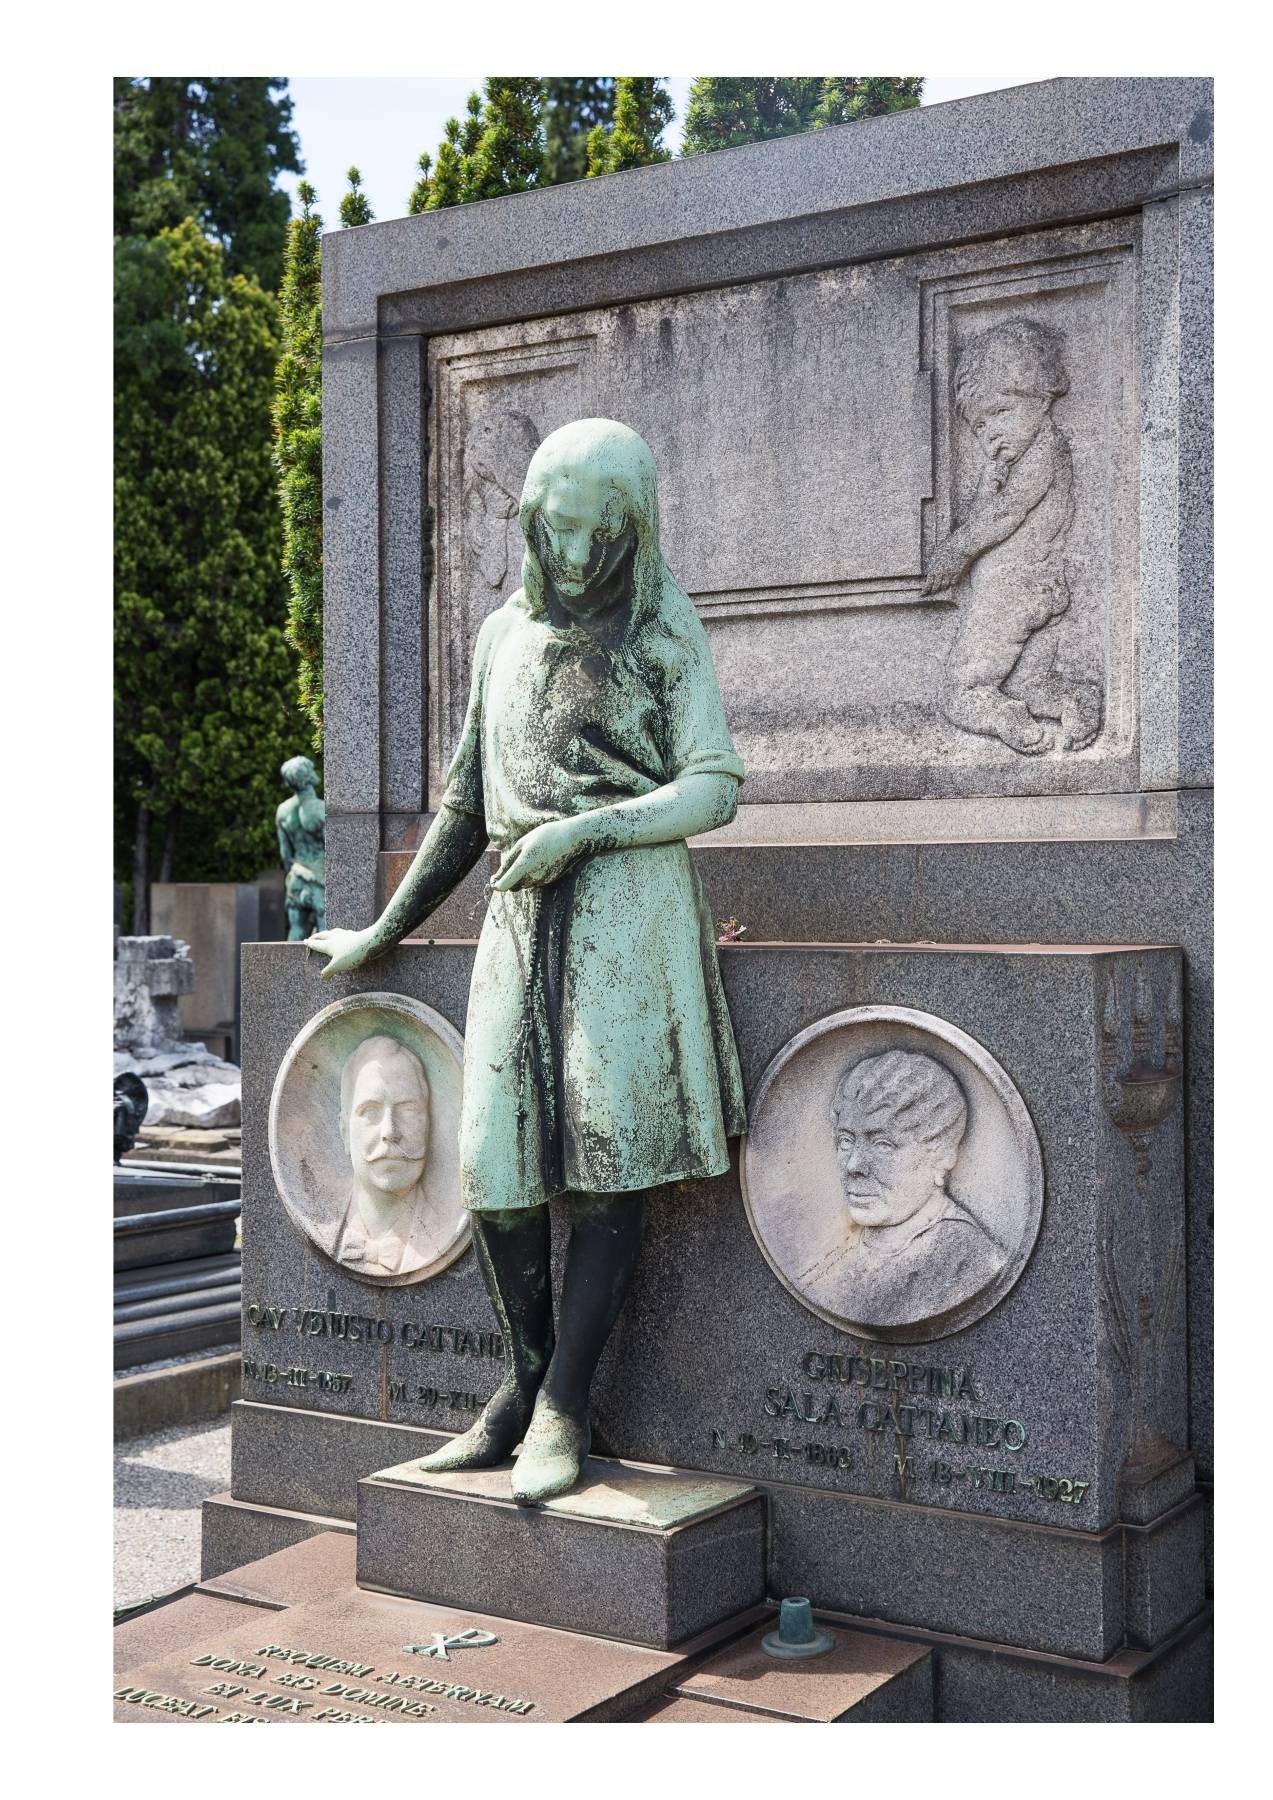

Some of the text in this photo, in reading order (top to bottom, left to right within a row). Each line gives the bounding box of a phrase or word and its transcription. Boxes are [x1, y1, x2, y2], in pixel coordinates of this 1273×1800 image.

[802, 1350, 979, 1401] GIUSEPPINA
[764, 1387, 1026, 1451] SALA CATTANEO
[113, 1686, 220, 1719] LUCEAT
[189, 1653, 437, 1718] DONA EIS DOMINE
[201, 1682, 250, 1699] ET
[243, 1692, 314, 1715] LUX
[253, 1644, 536, 1716] REQUIEM AETERNAM
